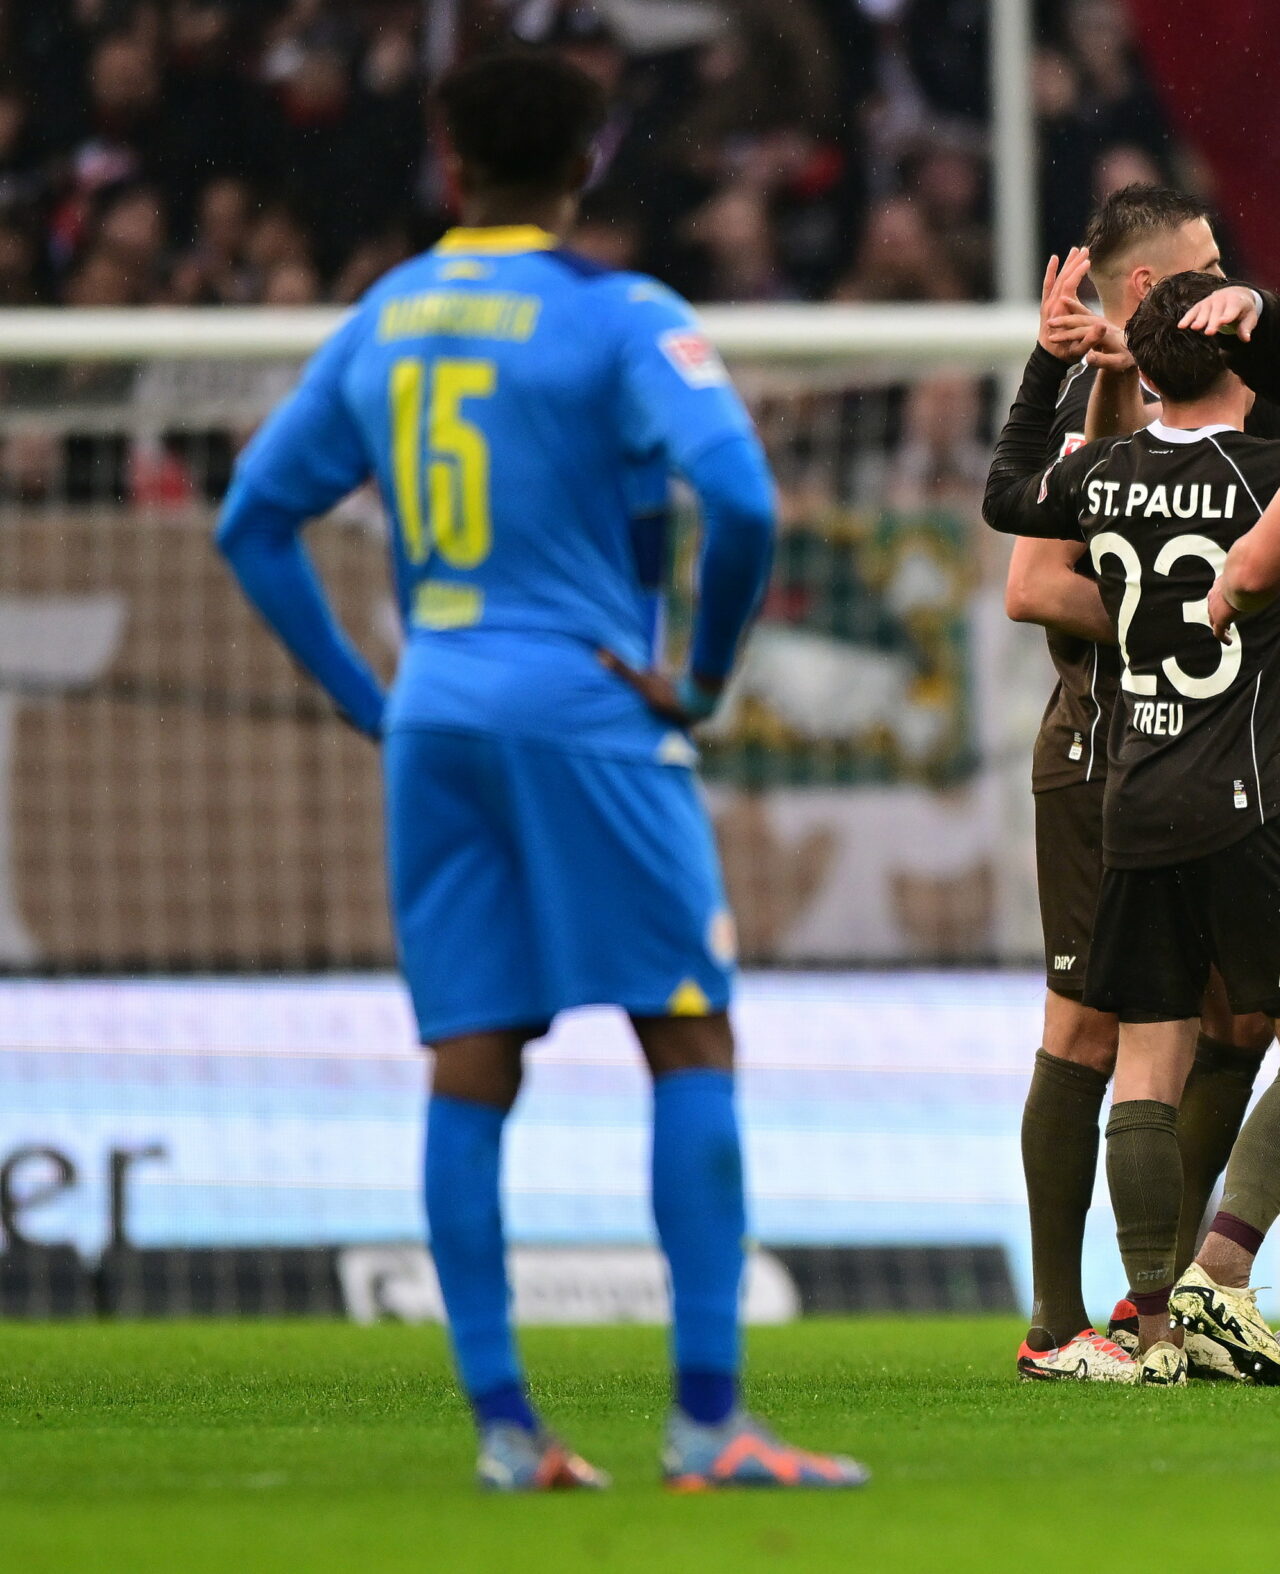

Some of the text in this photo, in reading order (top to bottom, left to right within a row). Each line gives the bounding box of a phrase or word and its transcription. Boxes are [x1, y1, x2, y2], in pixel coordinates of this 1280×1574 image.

[390, 357, 497, 569] 15
[1087, 480, 1120, 516] ST.
[1125, 483, 1237, 519] PAULI
[1090, 532, 1242, 699] 23
[1133, 702, 1184, 736] TREU
